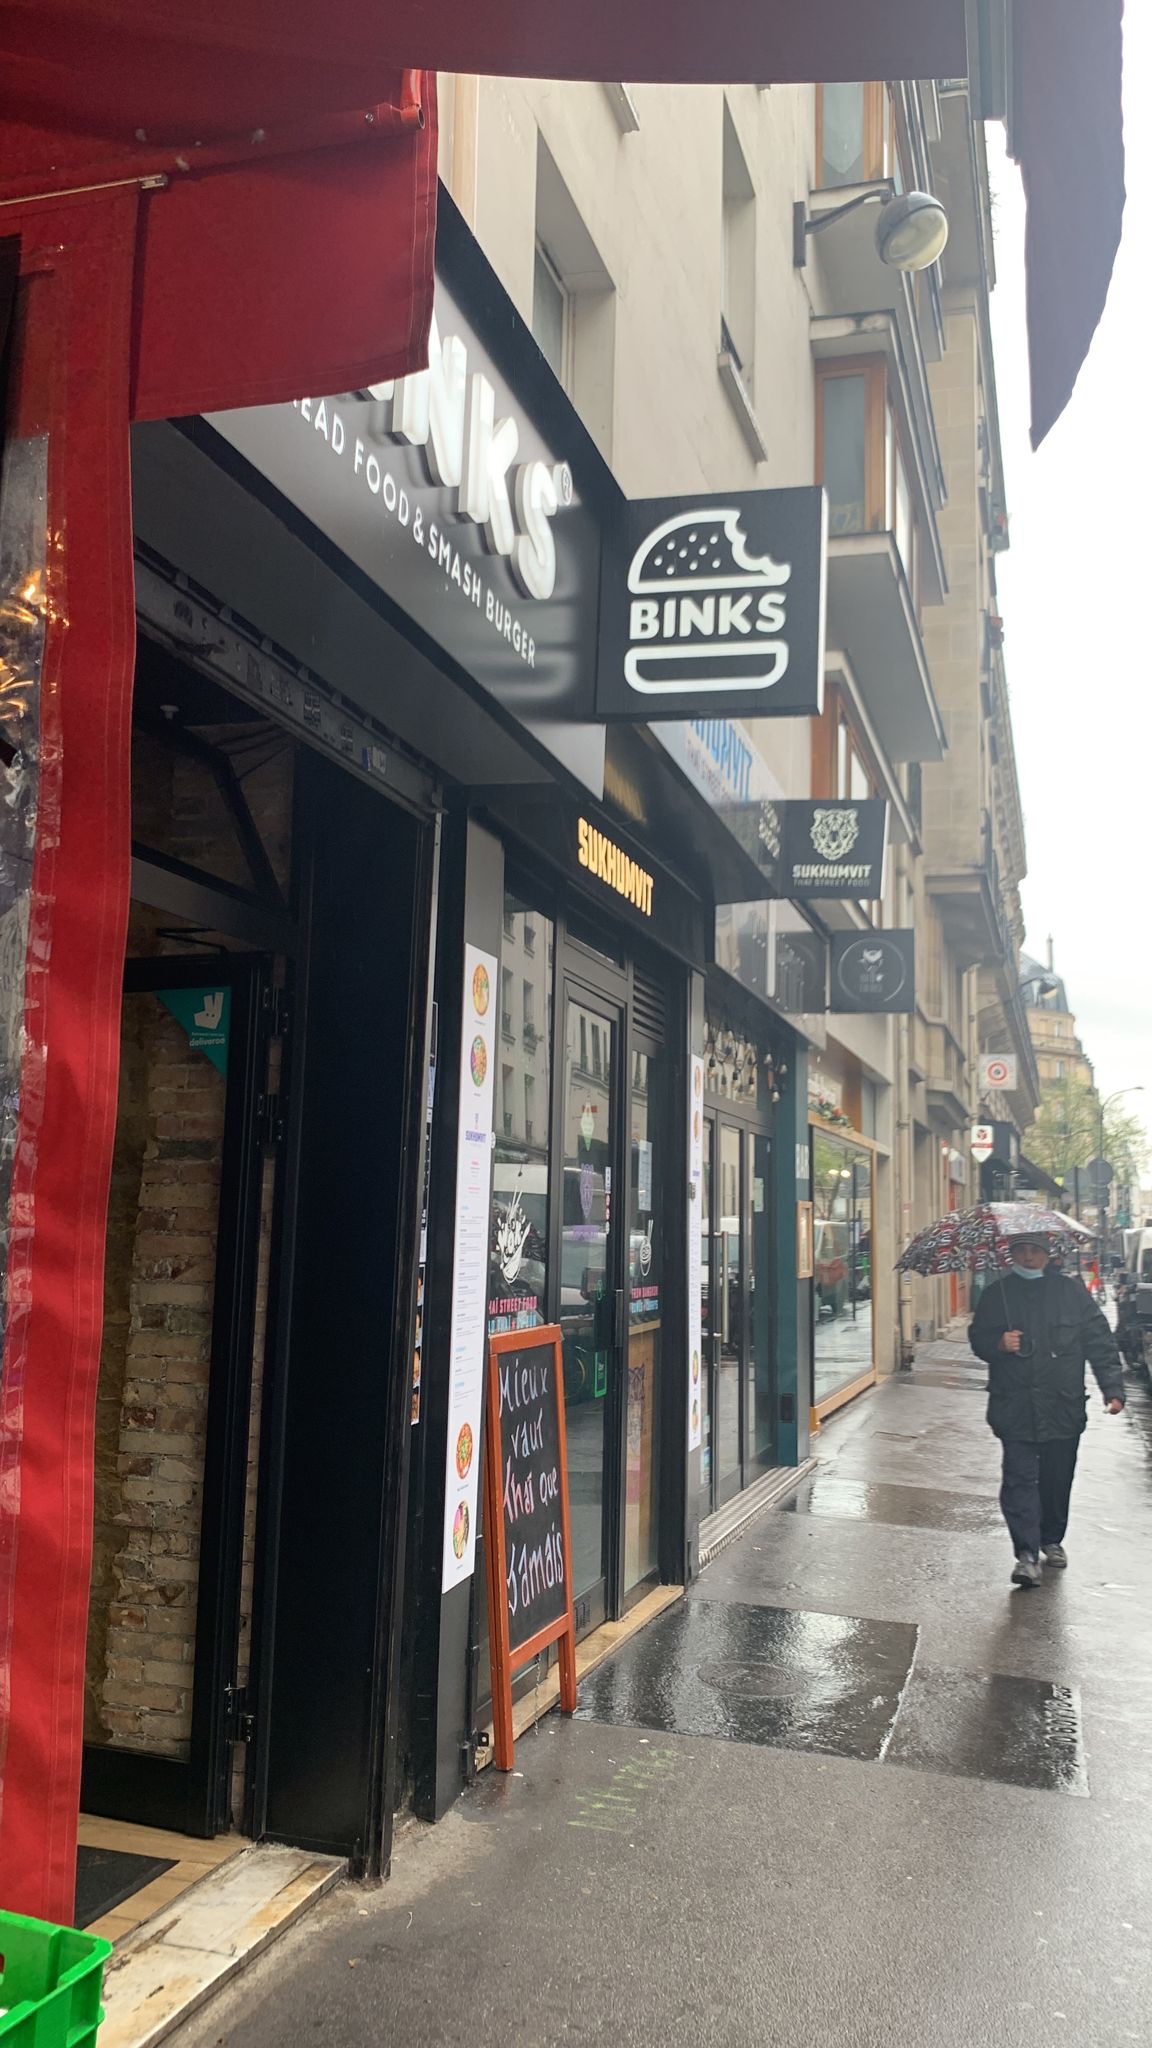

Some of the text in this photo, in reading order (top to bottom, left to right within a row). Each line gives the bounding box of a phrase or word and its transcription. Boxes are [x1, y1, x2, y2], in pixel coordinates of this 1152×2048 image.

[365, 312, 556, 600] NKS
[292, 397, 536, 668] EAD FOOD & SMASH BURGER
[629, 593, 786, 640] BINKS
[578, 817, 654, 916] SUKHUMVIT
[792, 864, 872, 879] SUKHUMVIT
[499, 1297, 521, 1314] STREET
[499, 1358, 549, 1418] Mieux
[511, 1407, 544, 1459] vaut
